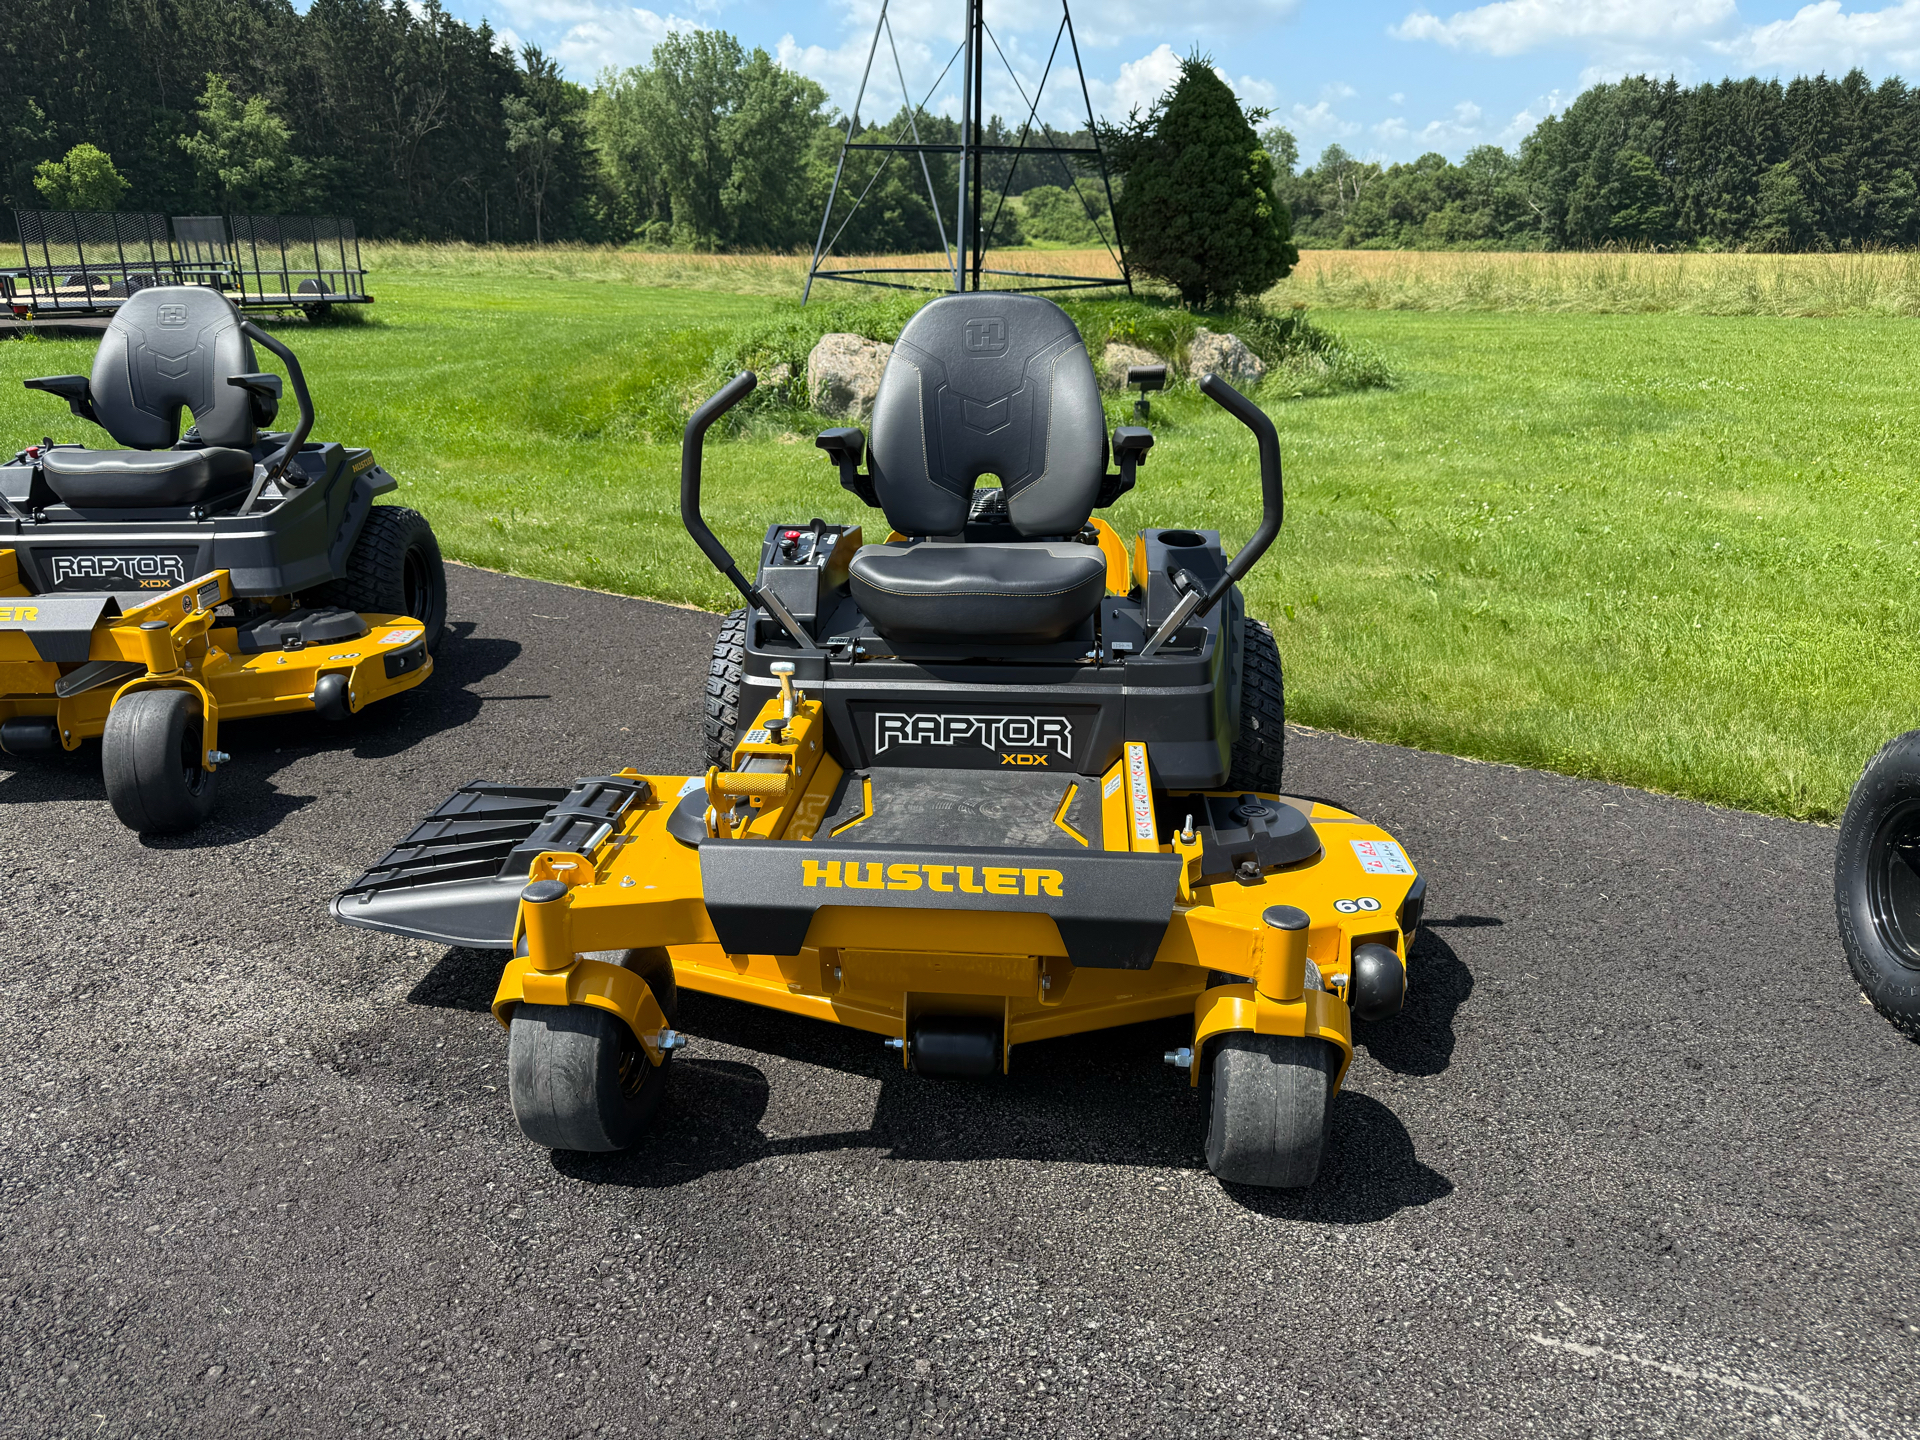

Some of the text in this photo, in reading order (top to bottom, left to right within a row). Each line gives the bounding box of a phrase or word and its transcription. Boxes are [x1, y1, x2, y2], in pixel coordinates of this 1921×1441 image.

[52, 555, 185, 585] RAPTOR
[139, 579, 172, 588] XDX
[875, 713, 1072, 759] RAPTOR
[1001, 754, 1049, 766] XDX
[802, 860, 1063, 897] HUSTLER
[1333, 897, 1381, 913] 60
